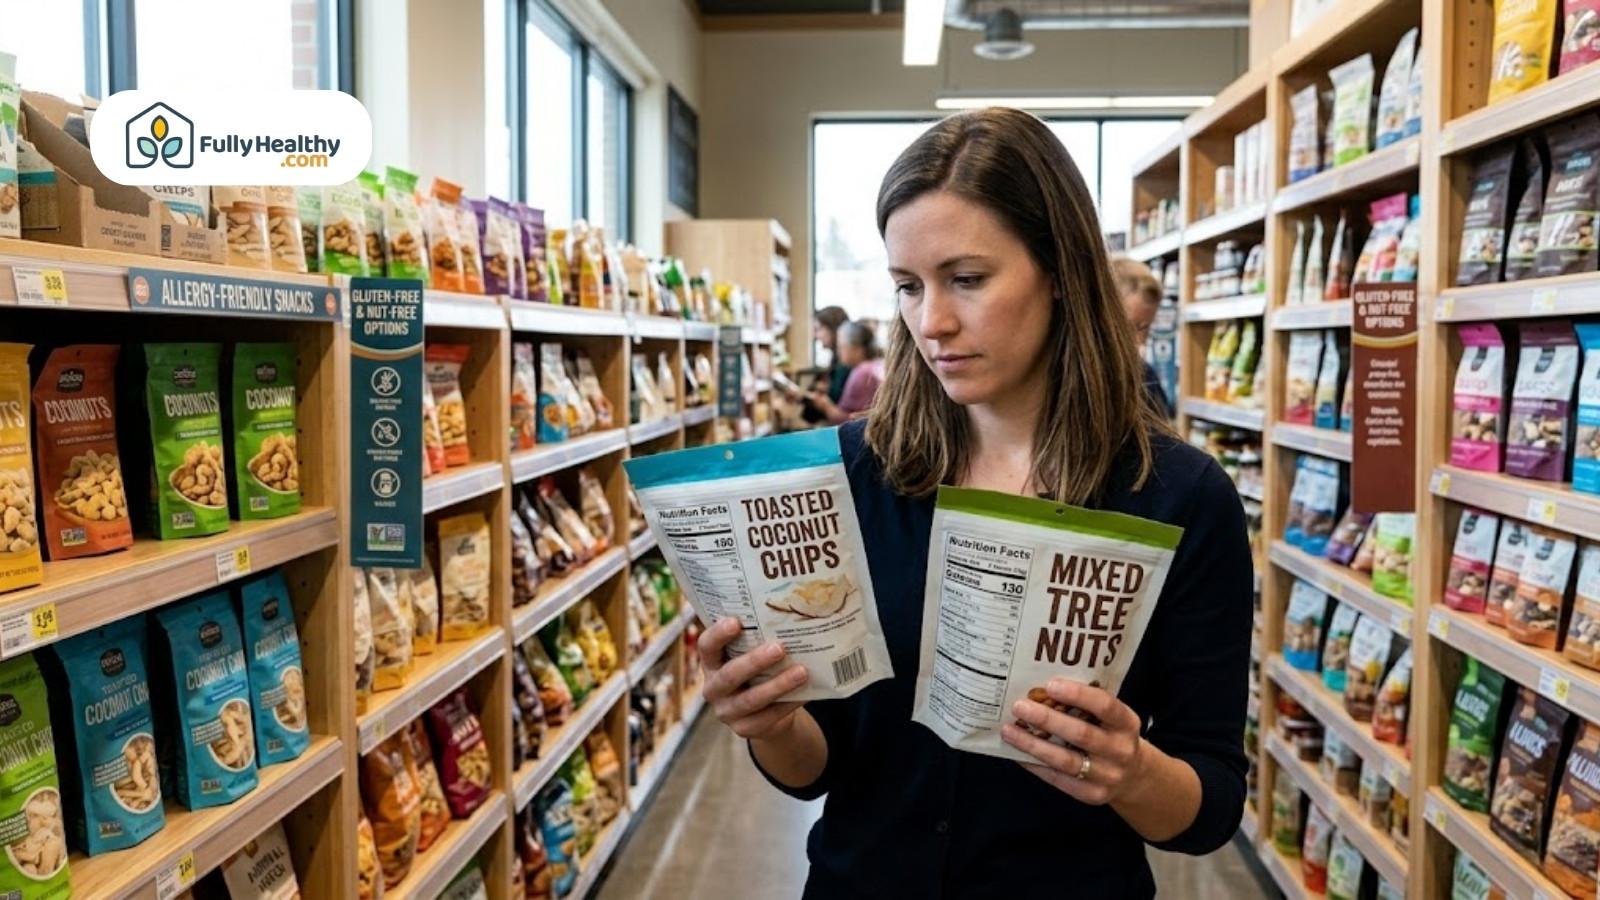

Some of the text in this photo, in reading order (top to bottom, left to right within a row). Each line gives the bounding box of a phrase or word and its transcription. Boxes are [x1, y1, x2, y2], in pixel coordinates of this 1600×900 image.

[162, 278, 315, 314] ALLERGY-FRIENDLY SNACKS
[352, 289, 420, 303] GLUTEN-FREE
[356, 304, 417, 320] & NUT-FREE
[1364, 316, 1406, 330] OPTIONS
[364, 321, 409, 335] OPTIONS
[43, 396, 112, 424] COCONUTS
[163, 391, 220, 417] COCONUTS
[658, 505, 728, 519] Nutrition Facts
[741, 489, 834, 522] TOASTED
[747, 512, 840, 549] COCONUT
[760, 541, 840, 580] CHIPS
[949, 535, 1031, 560] Nutrition Facts
[1050, 553, 1144, 594] MIXED
[1001, 581, 1024, 594] 130
[1047, 587, 1134, 632] TREE
[1034, 627, 1122, 669] NUTS
